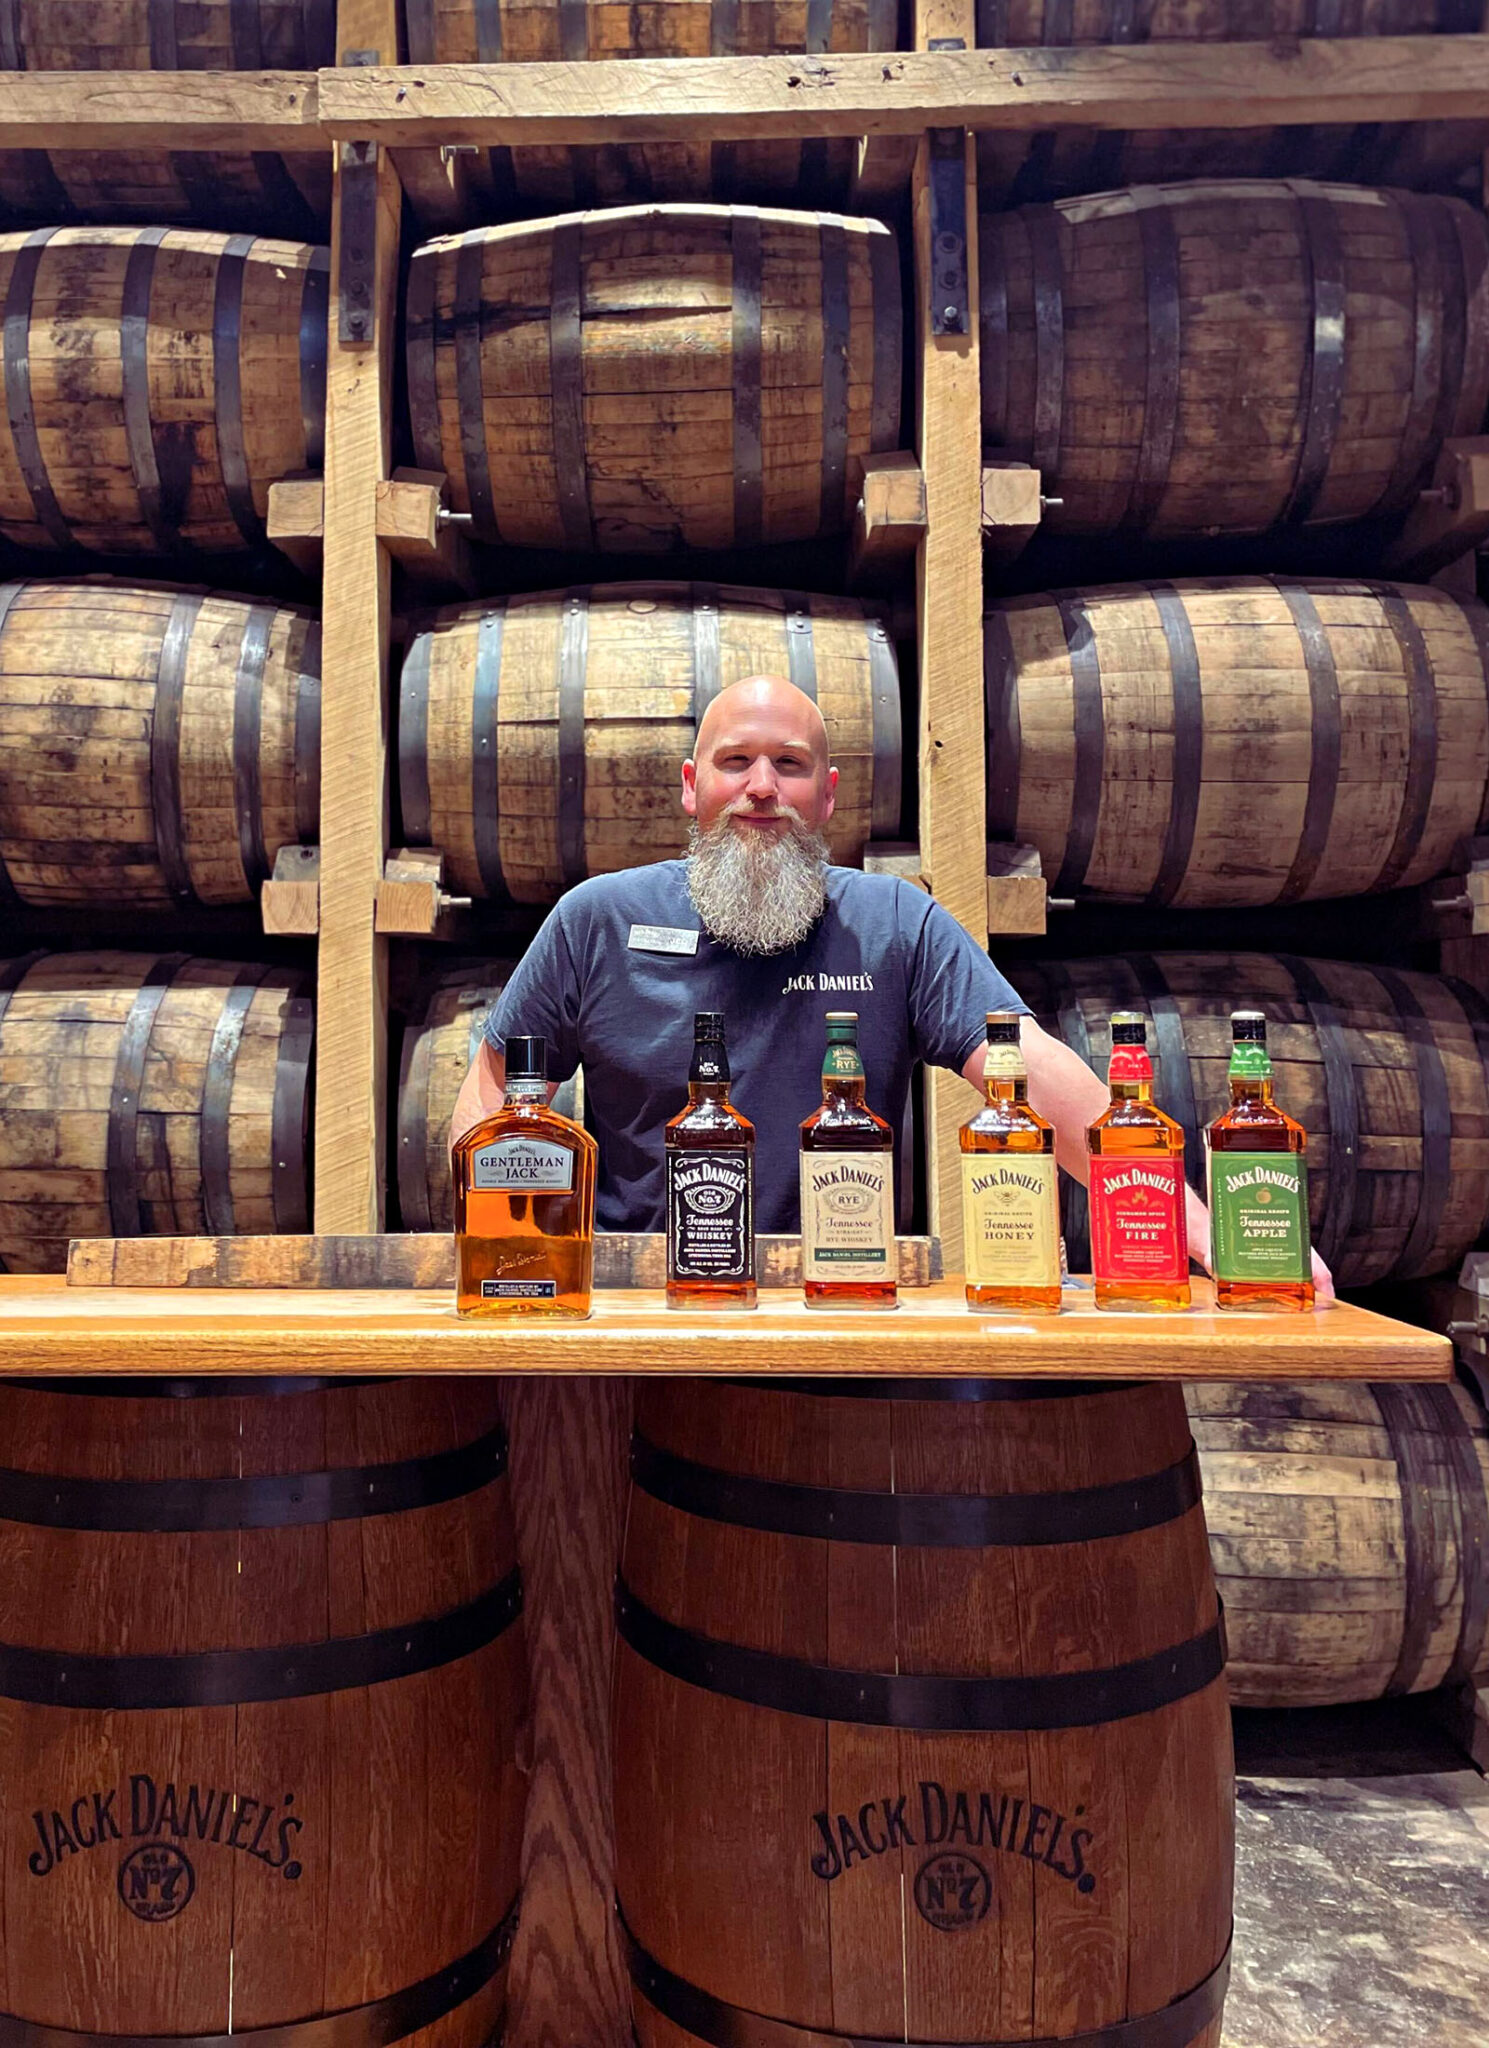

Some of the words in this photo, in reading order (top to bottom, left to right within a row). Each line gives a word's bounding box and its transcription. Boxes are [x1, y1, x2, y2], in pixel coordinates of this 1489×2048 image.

[782, 974, 816, 995] JACK
[818, 972, 875, 992] DANIEL'S
[836, 1060, 857, 1070] RYE
[480, 1157, 564, 1168] GENTLEMAN
[506, 1168, 539, 1180] JACK
[674, 1168, 702, 1192] JACK
[702, 1163, 747, 1194] DANIEL'S
[812, 1170, 840, 1192] JACK
[840, 1166, 885, 1192] DANIEL'S
[1226, 1170, 1256, 1192] JACK
[1254, 1166, 1301, 1194] DANIEL'S
[971, 1172, 999, 1195] JACK
[1000, 1168, 1045, 1195] DANIEL'S
[1102, 1173, 1132, 1195] JACK
[1132, 1168, 1176, 1196] DANIEL'S
[838, 1196, 860, 1204] RYE
[686, 1214, 734, 1226] Tennessee
[826, 1217, 873, 1228] Tennessee
[984, 1218, 1034, 1230] Tennessee
[1116, 1218, 1167, 1230] Tennessee
[1240, 1215, 1292, 1228] Tennessee
[686, 1232, 734, 1240] WHISKEY
[984, 1232, 1035, 1240] HONEY
[1126, 1232, 1159, 1240] FIRE
[1242, 1228, 1288, 1238] APPLE
[28, 1788, 123, 1877] JACK
[129, 1773, 304, 1868] DANIEL'S
[811, 1794, 917, 1881] JACK
[919, 1781, 1095, 1880] DANIEL'S
